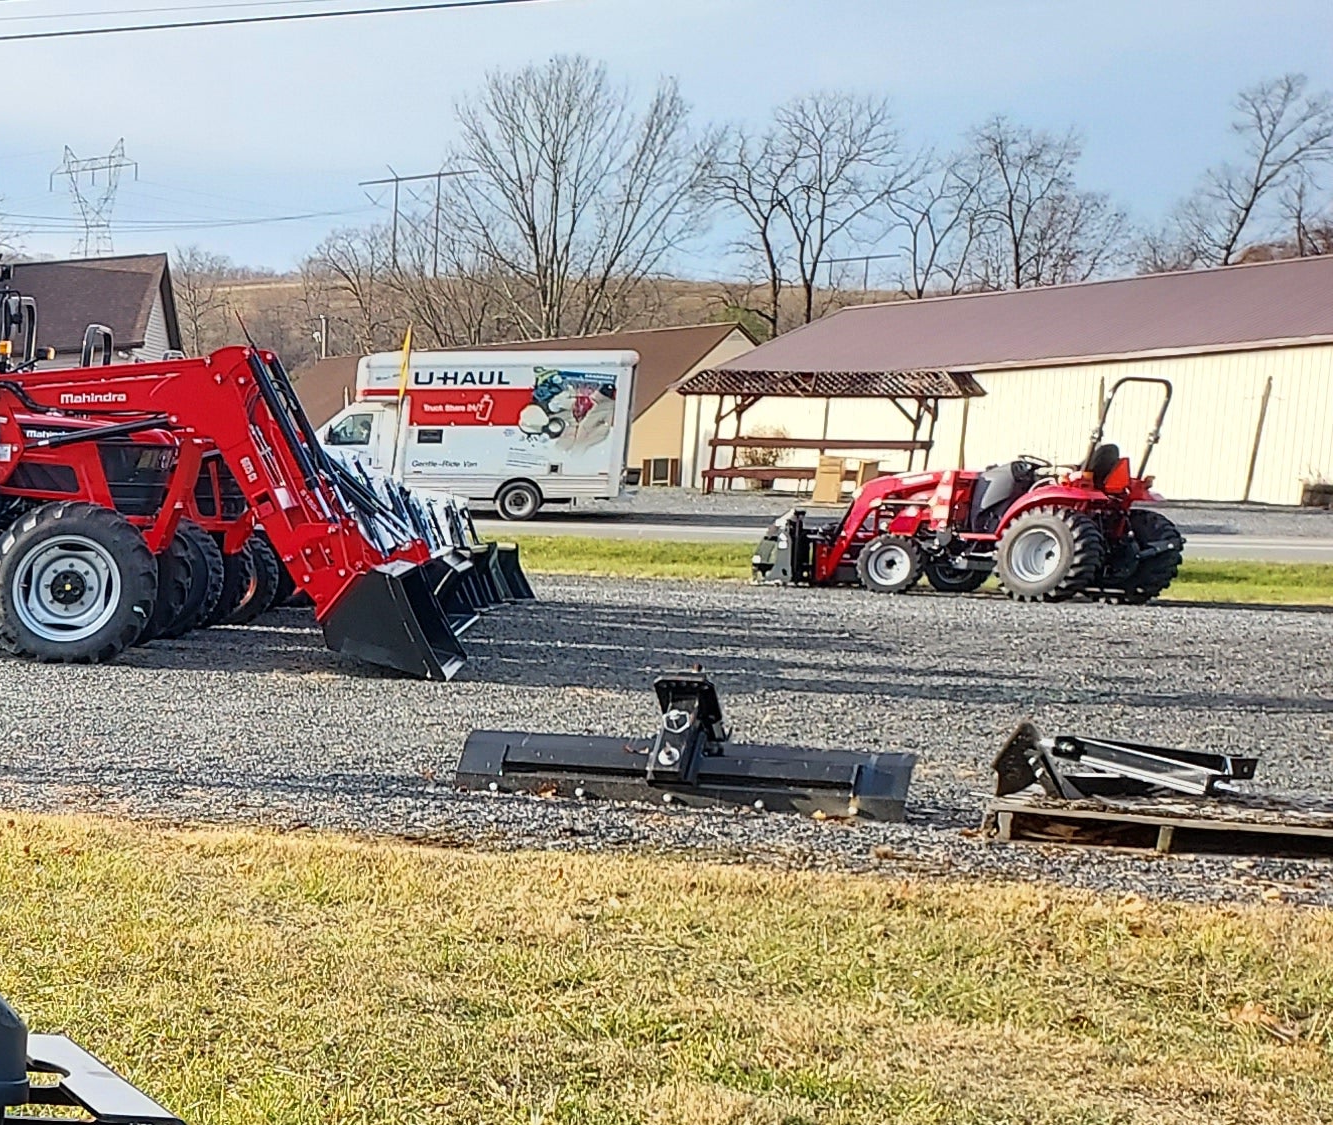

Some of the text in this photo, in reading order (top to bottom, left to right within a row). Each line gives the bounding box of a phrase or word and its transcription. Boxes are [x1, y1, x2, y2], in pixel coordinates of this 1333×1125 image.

[414, 371, 510, 385] U-HAUL
[60, 392, 127, 404] Mahindra
[423, 404, 443, 412] Truck
